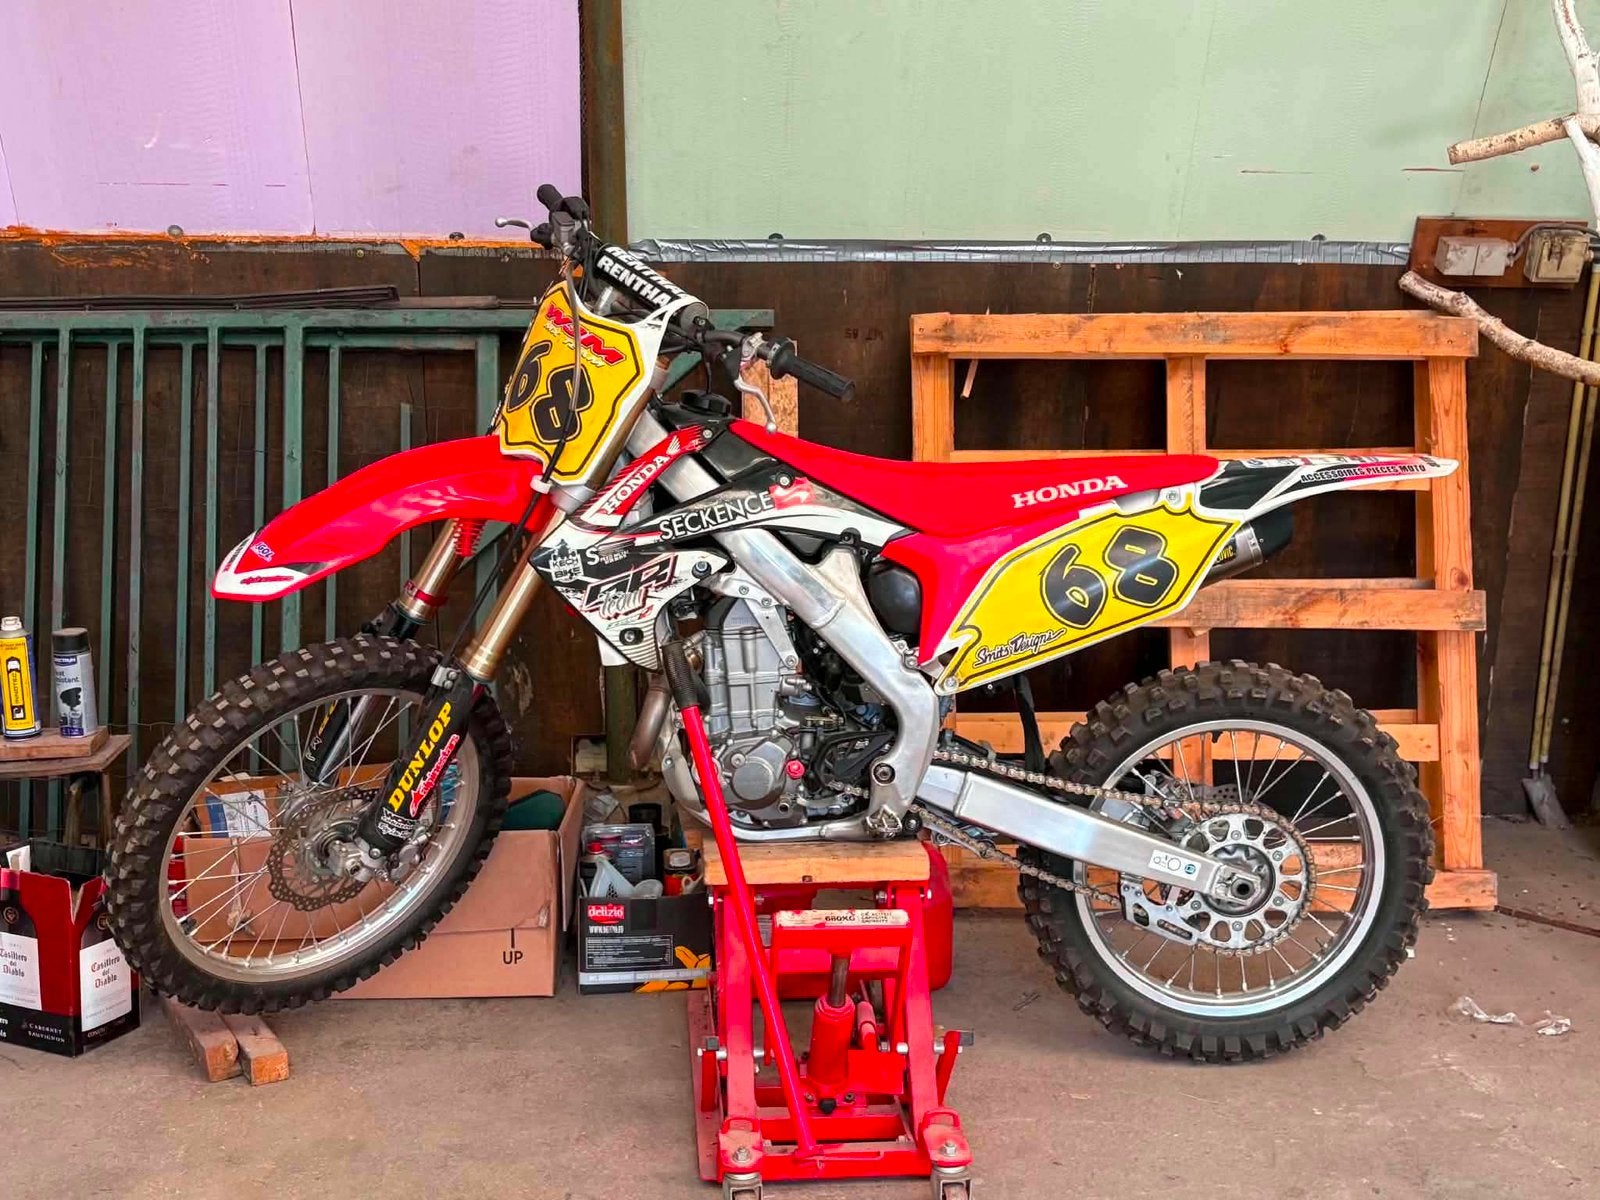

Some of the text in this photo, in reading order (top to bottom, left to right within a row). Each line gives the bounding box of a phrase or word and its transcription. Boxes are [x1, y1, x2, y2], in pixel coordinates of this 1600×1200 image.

[506, 340, 595, 444] 68
[607, 455, 671, 515] HONDA
[1011, 475, 1128, 508] HONDA
[1300, 463, 1426, 483] ACCESSOIRES PIECES MOTO
[659, 490, 775, 541] SECKENCE
[1040, 525, 1180, 630] 68
[1009, 630, 1067, 655] Designs
[388, 701, 452, 812] DUNLOP
[502, 950, 524, 965] UP
